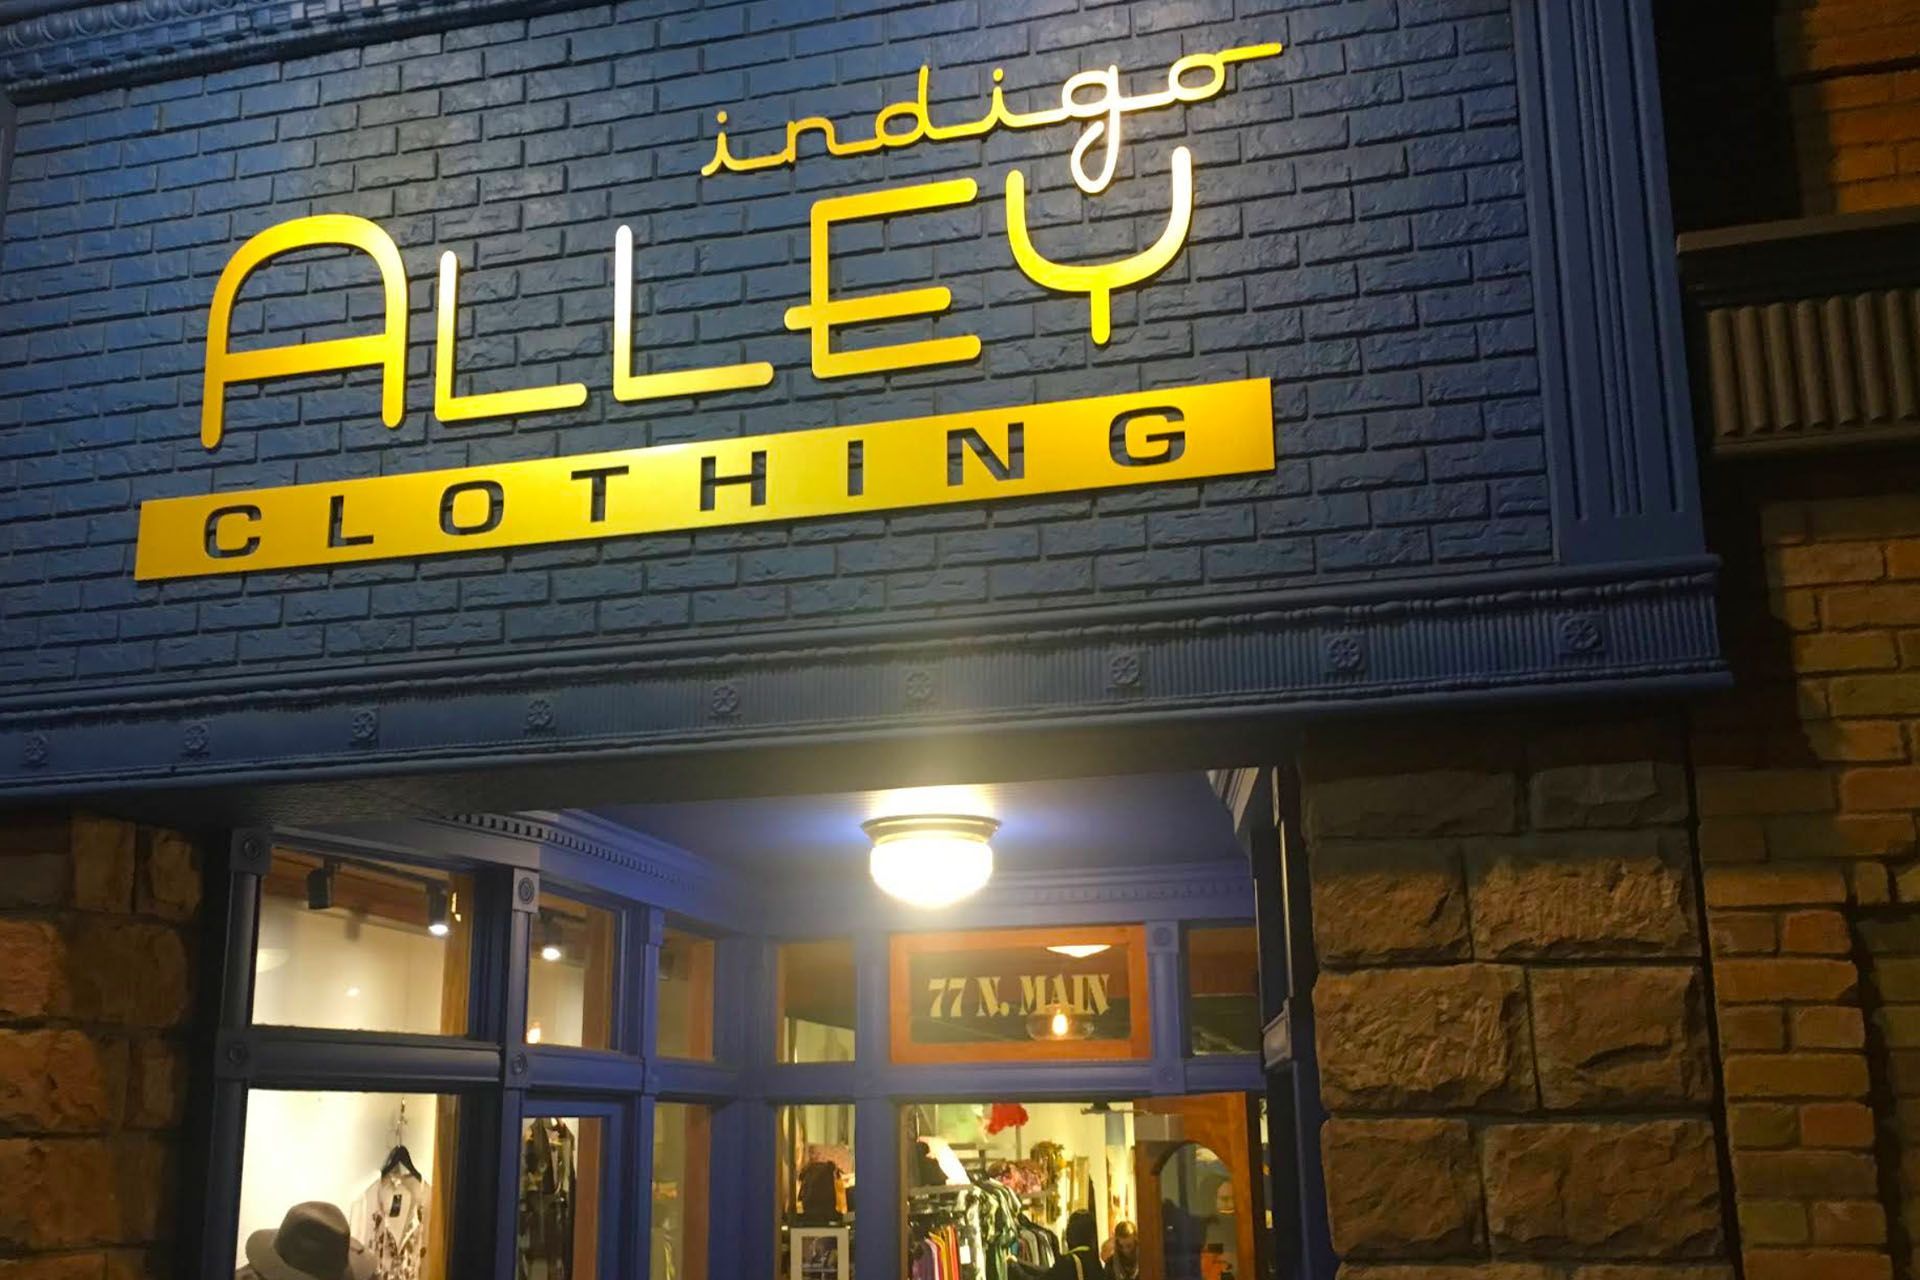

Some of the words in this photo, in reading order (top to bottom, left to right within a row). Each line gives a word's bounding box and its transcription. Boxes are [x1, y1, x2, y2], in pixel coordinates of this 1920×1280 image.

[700, 42, 1283, 194] indigo
[199, 146, 1193, 449] ALLEY
[204, 404, 1186, 559] CLOTHING
[928, 977, 967, 1018] 77
[975, 976, 1010, 1018] N.
[1018, 974, 1111, 1016] MAIN
